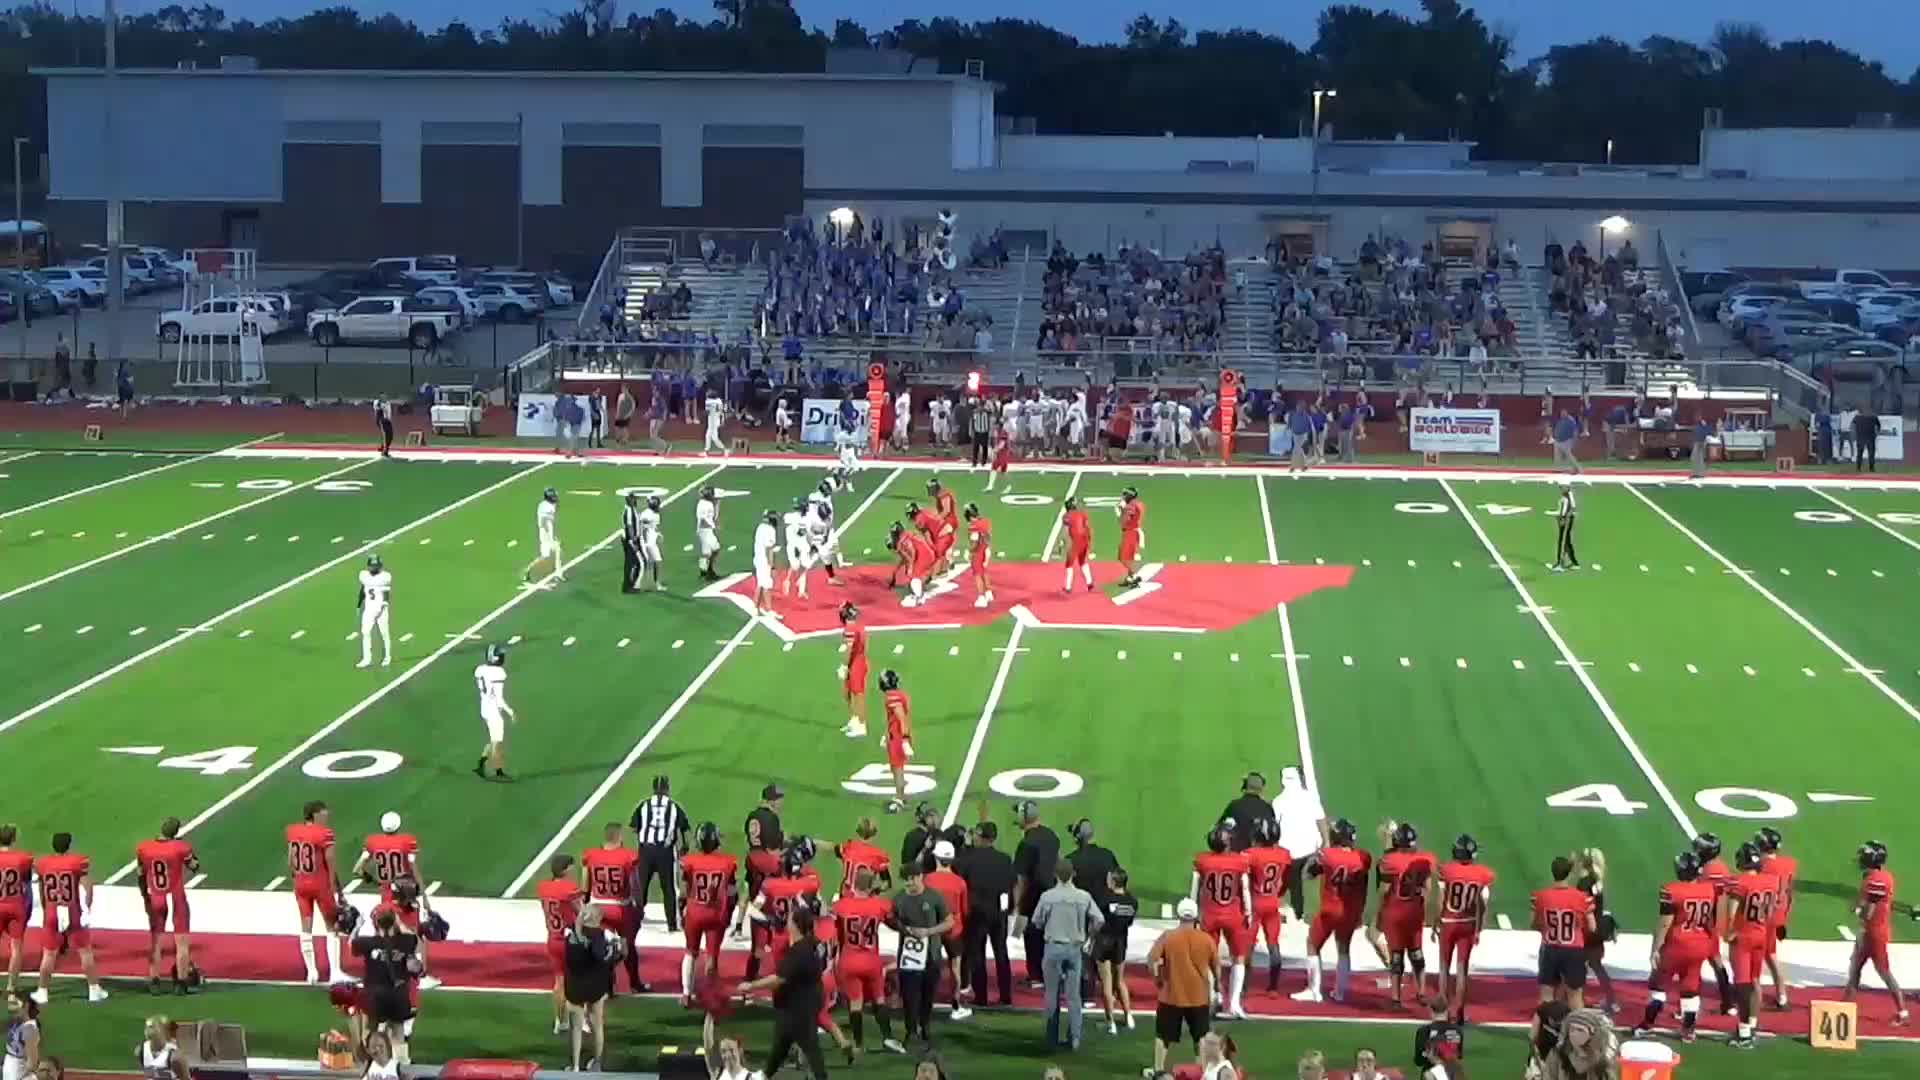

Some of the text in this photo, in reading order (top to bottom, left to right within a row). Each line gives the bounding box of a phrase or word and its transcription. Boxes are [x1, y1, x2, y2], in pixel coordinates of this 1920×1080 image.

[44, 871, 74, 902] 23
[153, 859, 168, 889] 8
[594, 866, 621, 896] 55
[1205, 870, 1234, 903] 46
[548, 899, 562, 930] 5
[1545, 908, 1575, 944] 58
[846, 915, 878, 947] 54
[1819, 1011, 1849, 1041] 40
